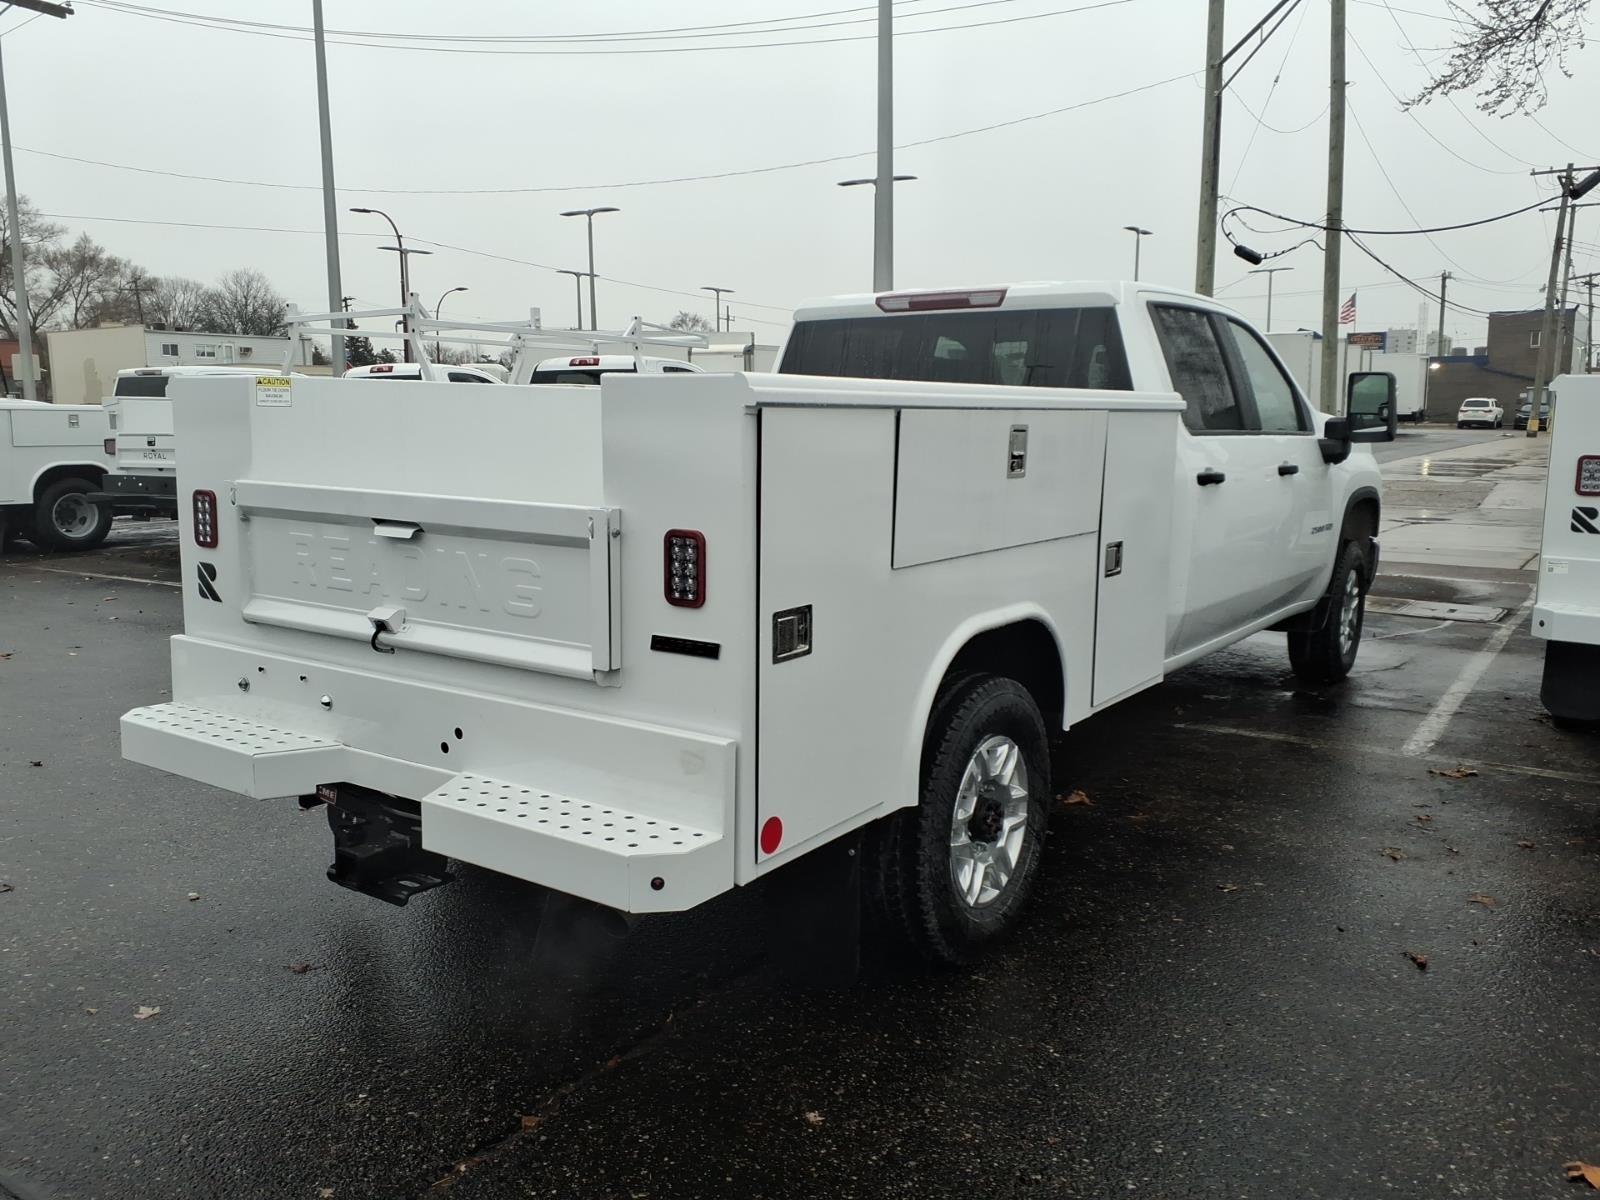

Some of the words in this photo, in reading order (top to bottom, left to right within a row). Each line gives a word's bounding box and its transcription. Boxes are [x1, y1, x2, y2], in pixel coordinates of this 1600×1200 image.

[262, 378, 290, 386] CAUTION
[143, 452, 167, 460] ROYAL
[288, 530, 543, 619] READING
